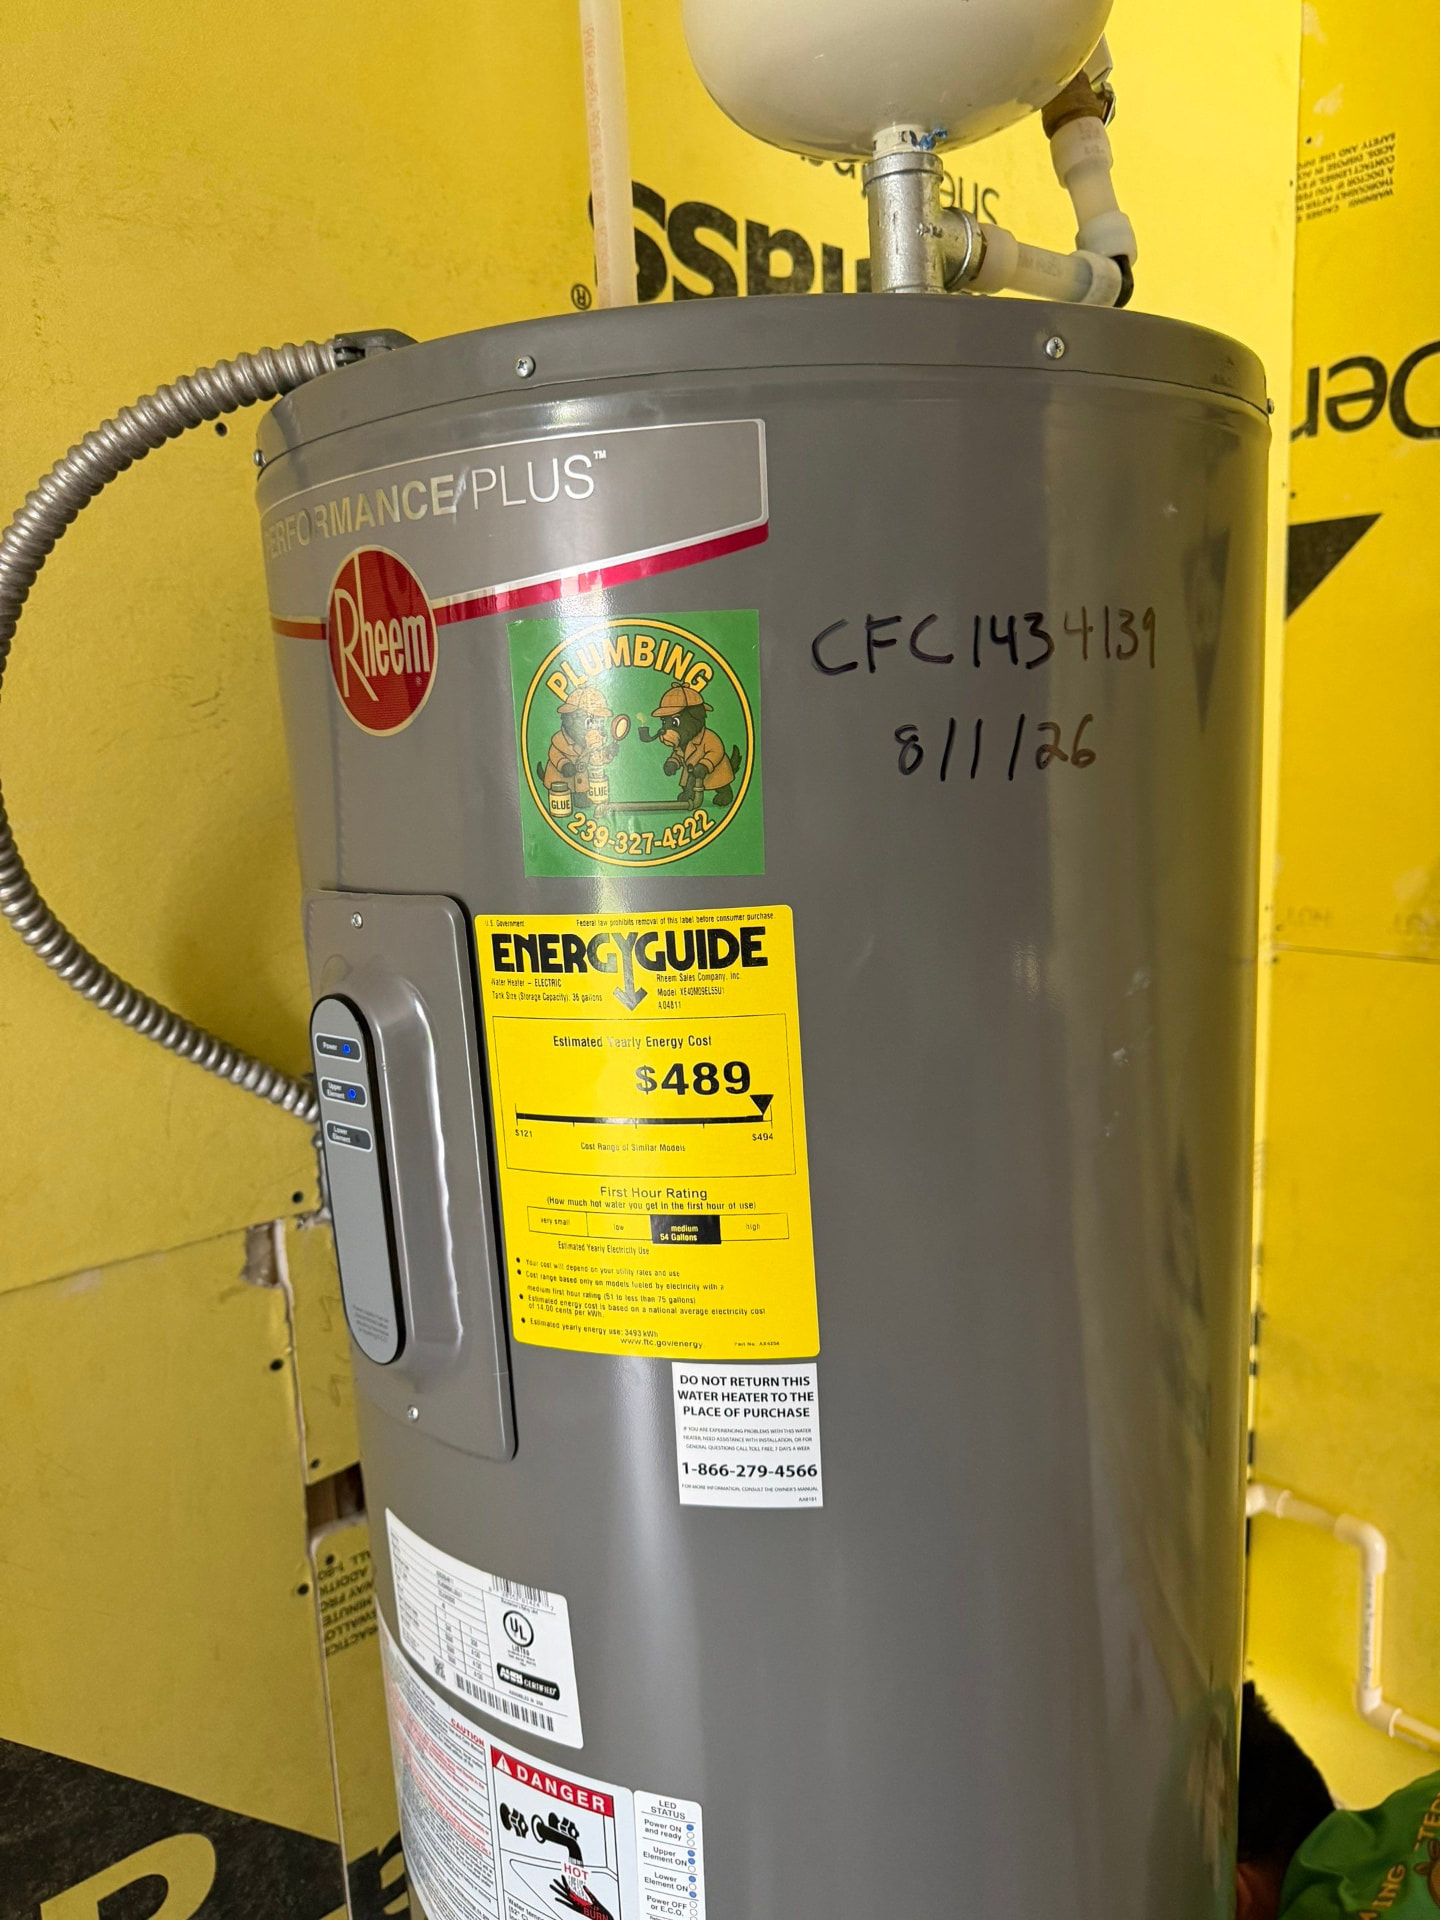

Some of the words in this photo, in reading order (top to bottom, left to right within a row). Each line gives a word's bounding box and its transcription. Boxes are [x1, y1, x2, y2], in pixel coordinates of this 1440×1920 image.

[264, 474, 459, 560] PERFORMANCE
[546, 634, 714, 702] PLUMBING
[894, 713, 1098, 782] 8/1/26
[551, 797, 571, 811] GLUE
[567, 809, 714, 856] 239-327-4222
[576, 918, 597, 926] Federal
[598, 918, 608, 926] law
[610, 918, 634, 928] prohibits
[636, 917, 658, 925] removal
[667, 916, 678, 924] this
[680, 916, 694, 924] label
[696, 915, 714, 923] before
[716, 914, 745, 922] consumer
[491, 926, 768, 973] ENERGYGUIDE
[507, 978, 525, 987] Heater
[535, 978, 562, 988] ELECTRIC
[657, 972, 677, 982] Rheem
[680, 973, 695, 981] Sales
[492, 991, 505, 1000] Tank
[506, 991, 517, 1000] Size
[581, 993, 602, 1003] gallons
[323, 1041, 337, 1051] Power
[553, 1035, 603, 1048] Estimated
[607, 1035, 641, 1049] Yearly
[646, 1035, 684, 1049] Energy
[688, 1034, 712, 1047] Cost
[635, 1060, 751, 1096] $489
[515, 1128, 533, 1138] $121
[752, 1132, 774, 1142] $494
[580, 1142, 595, 1151] Cost
[597, 1142, 620, 1152] Range
[622, 1142, 630, 1151] of
[631, 1143, 657, 1152] Similar
[660, 1143, 686, 1152] Models
[601, 1187, 628, 1198] First
[632, 1188, 662, 1199] Hour
[666, 1188, 707, 1201] Rating
[547, 1196, 565, 1205] (How
[568, 1198, 588, 1207] much
[590, 1198, 602, 1208] hot
[605, 1200, 625, 1209] water
[629, 1202, 643, 1211] you
[645, 1201, 658, 1211] get
[660, 1201, 669, 1210] in
[671, 1201, 684, 1210] the
[687, 1200, 704, 1210] first
[706, 1200, 724, 1210] hour
[728, 1202, 737, 1210] of
[739, 1202, 756, 1211] use)
[671, 1224, 698, 1233] medium
[745, 1223, 760, 1232] high
[660, 1233, 669, 1241] 54
[671, 1233, 698, 1241] Gallons
[558, 1241, 586, 1252] Estimated
[587, 1243, 605, 1253] Yearly
[607, 1244, 637, 1255] Electricity
[638, 1246, 650, 1255] Use
[526, 1271, 539, 1280] Cost
[540, 1273, 557, 1283] range
[559, 1275, 578, 1284] based
[580, 1277, 593, 1287] only
[606, 1279, 629, 1288] models
[632, 1280, 653, 1289] fueled
[655, 1282, 664, 1291] by
[666, 1283, 700, 1292] electricity
[703, 1283, 718, 1291] with
[528, 1295, 558, 1306] Estimated
[560, 1299, 582, 1310] energy
[584, 1301, 598, 1311] cost
[599, 1302, 606, 1311] is
[608, 1303, 629, 1312] based
[630, 1305, 640, 1313] on
[648, 1306, 678, 1314] national
[680, 1308, 709, 1317] average
[711, 1307, 748, 1317] electricity
[750, 1307, 766, 1315] cost
[621, 1337, 703, 1350] www.ftc.gov/energy
[680, 1374, 698, 1385] DO
[701, 1375, 727, 1386] NOT
[730, 1376, 779, 1387] RETURN
[782, 1376, 810, 1386] THIS
[678, 1389, 718, 1402] WATER
[721, 1391, 768, 1403] HEATER
[769, 1392, 787, 1402] TO
[790, 1391, 814, 1402] THE
[683, 1405, 721, 1417] PLACE
[724, 1408, 741, 1417] OF
[744, 1407, 810, 1418] PURCHASE
[682, 1462, 818, 1478] 1-866-279-4566
[451, 1718, 485, 1747] CAUTION
[517, 1764, 605, 1813] DANGER
[659, 1800, 676, 1810] LED
[651, 1806, 685, 1820] STATUS
[644, 1818, 667, 1830] Power
[669, 1824, 682, 1833] ON
[645, 1827, 659, 1835] and
[660, 1831, 682, 1841] ready
[643, 1850, 673, 1864] Element
[674, 1858, 687, 1867] ON
[653, 1846, 676, 1857] Upper
[564, 1862, 588, 1881] HOT
[654, 1871, 677, 1882] Lower
[644, 1876, 674, 1890] Element
[675, 1884, 688, 1892] ON
[646, 1894, 670, 1906] Power
[671, 1901, 687, 1910] OFF
[660, 1905, 684, 1918] E.C.O.
